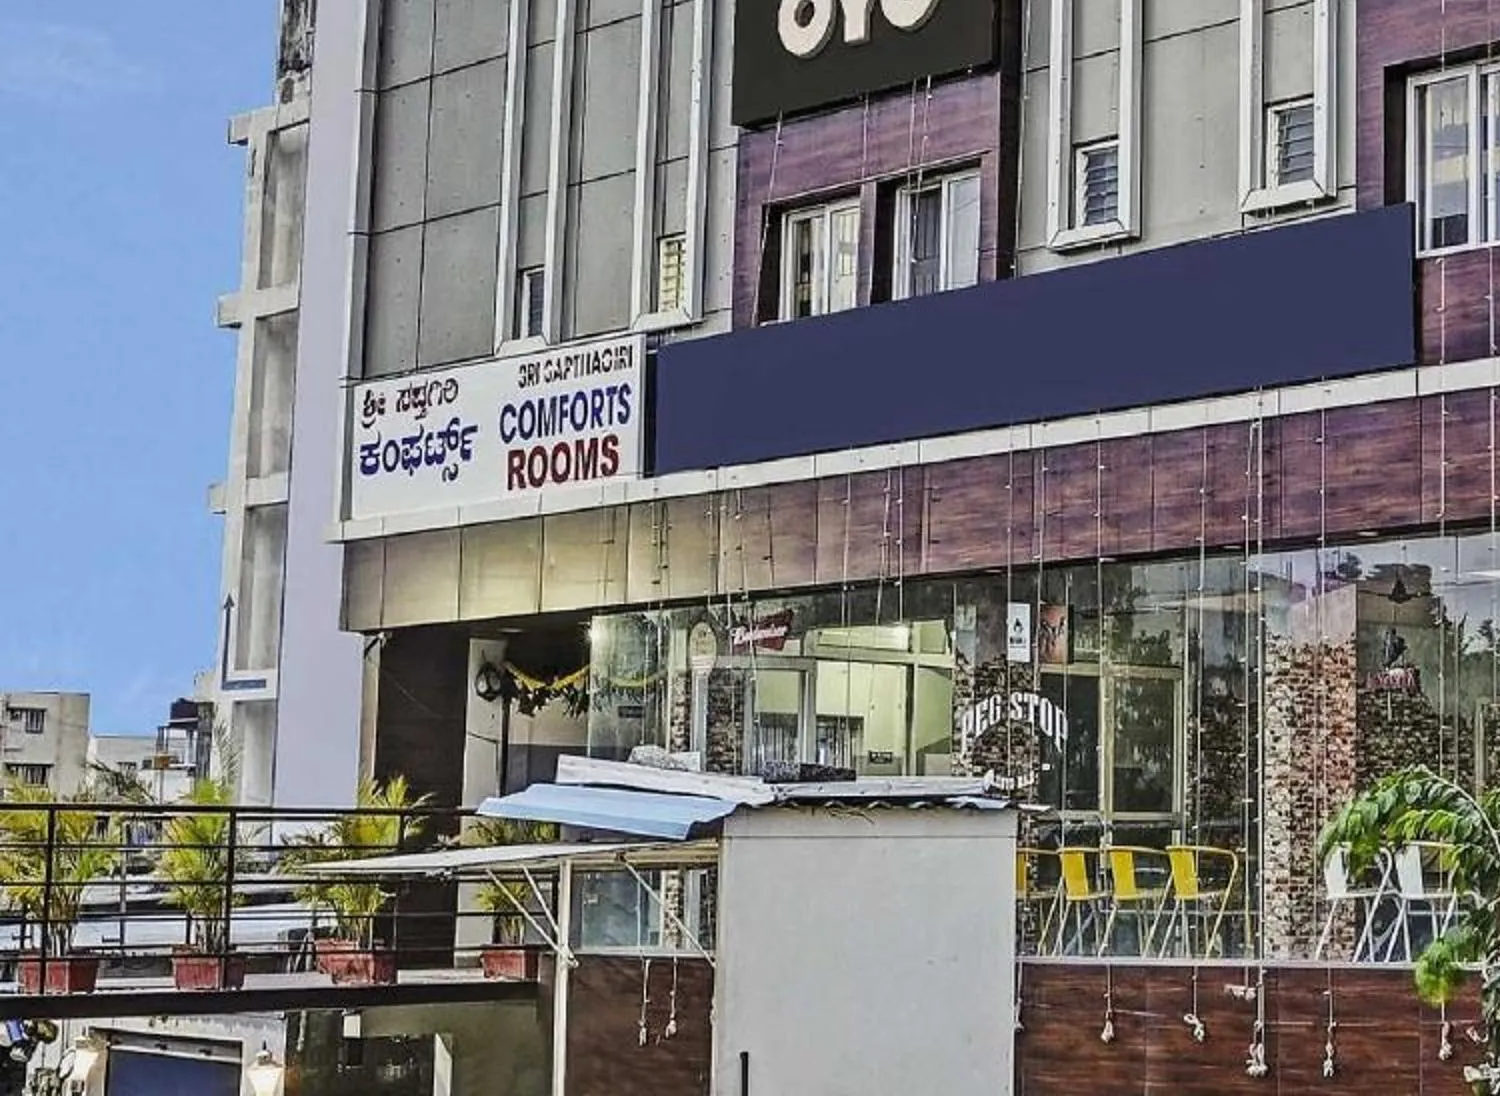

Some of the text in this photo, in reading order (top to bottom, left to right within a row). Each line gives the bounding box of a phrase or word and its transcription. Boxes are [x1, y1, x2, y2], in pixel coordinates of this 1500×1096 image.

[518, 361, 541, 389] SRI
[499, 382, 632, 445] COMFORTS
[507, 433, 620, 492] ROOMS
[1009, 691, 1069, 753] STOP
